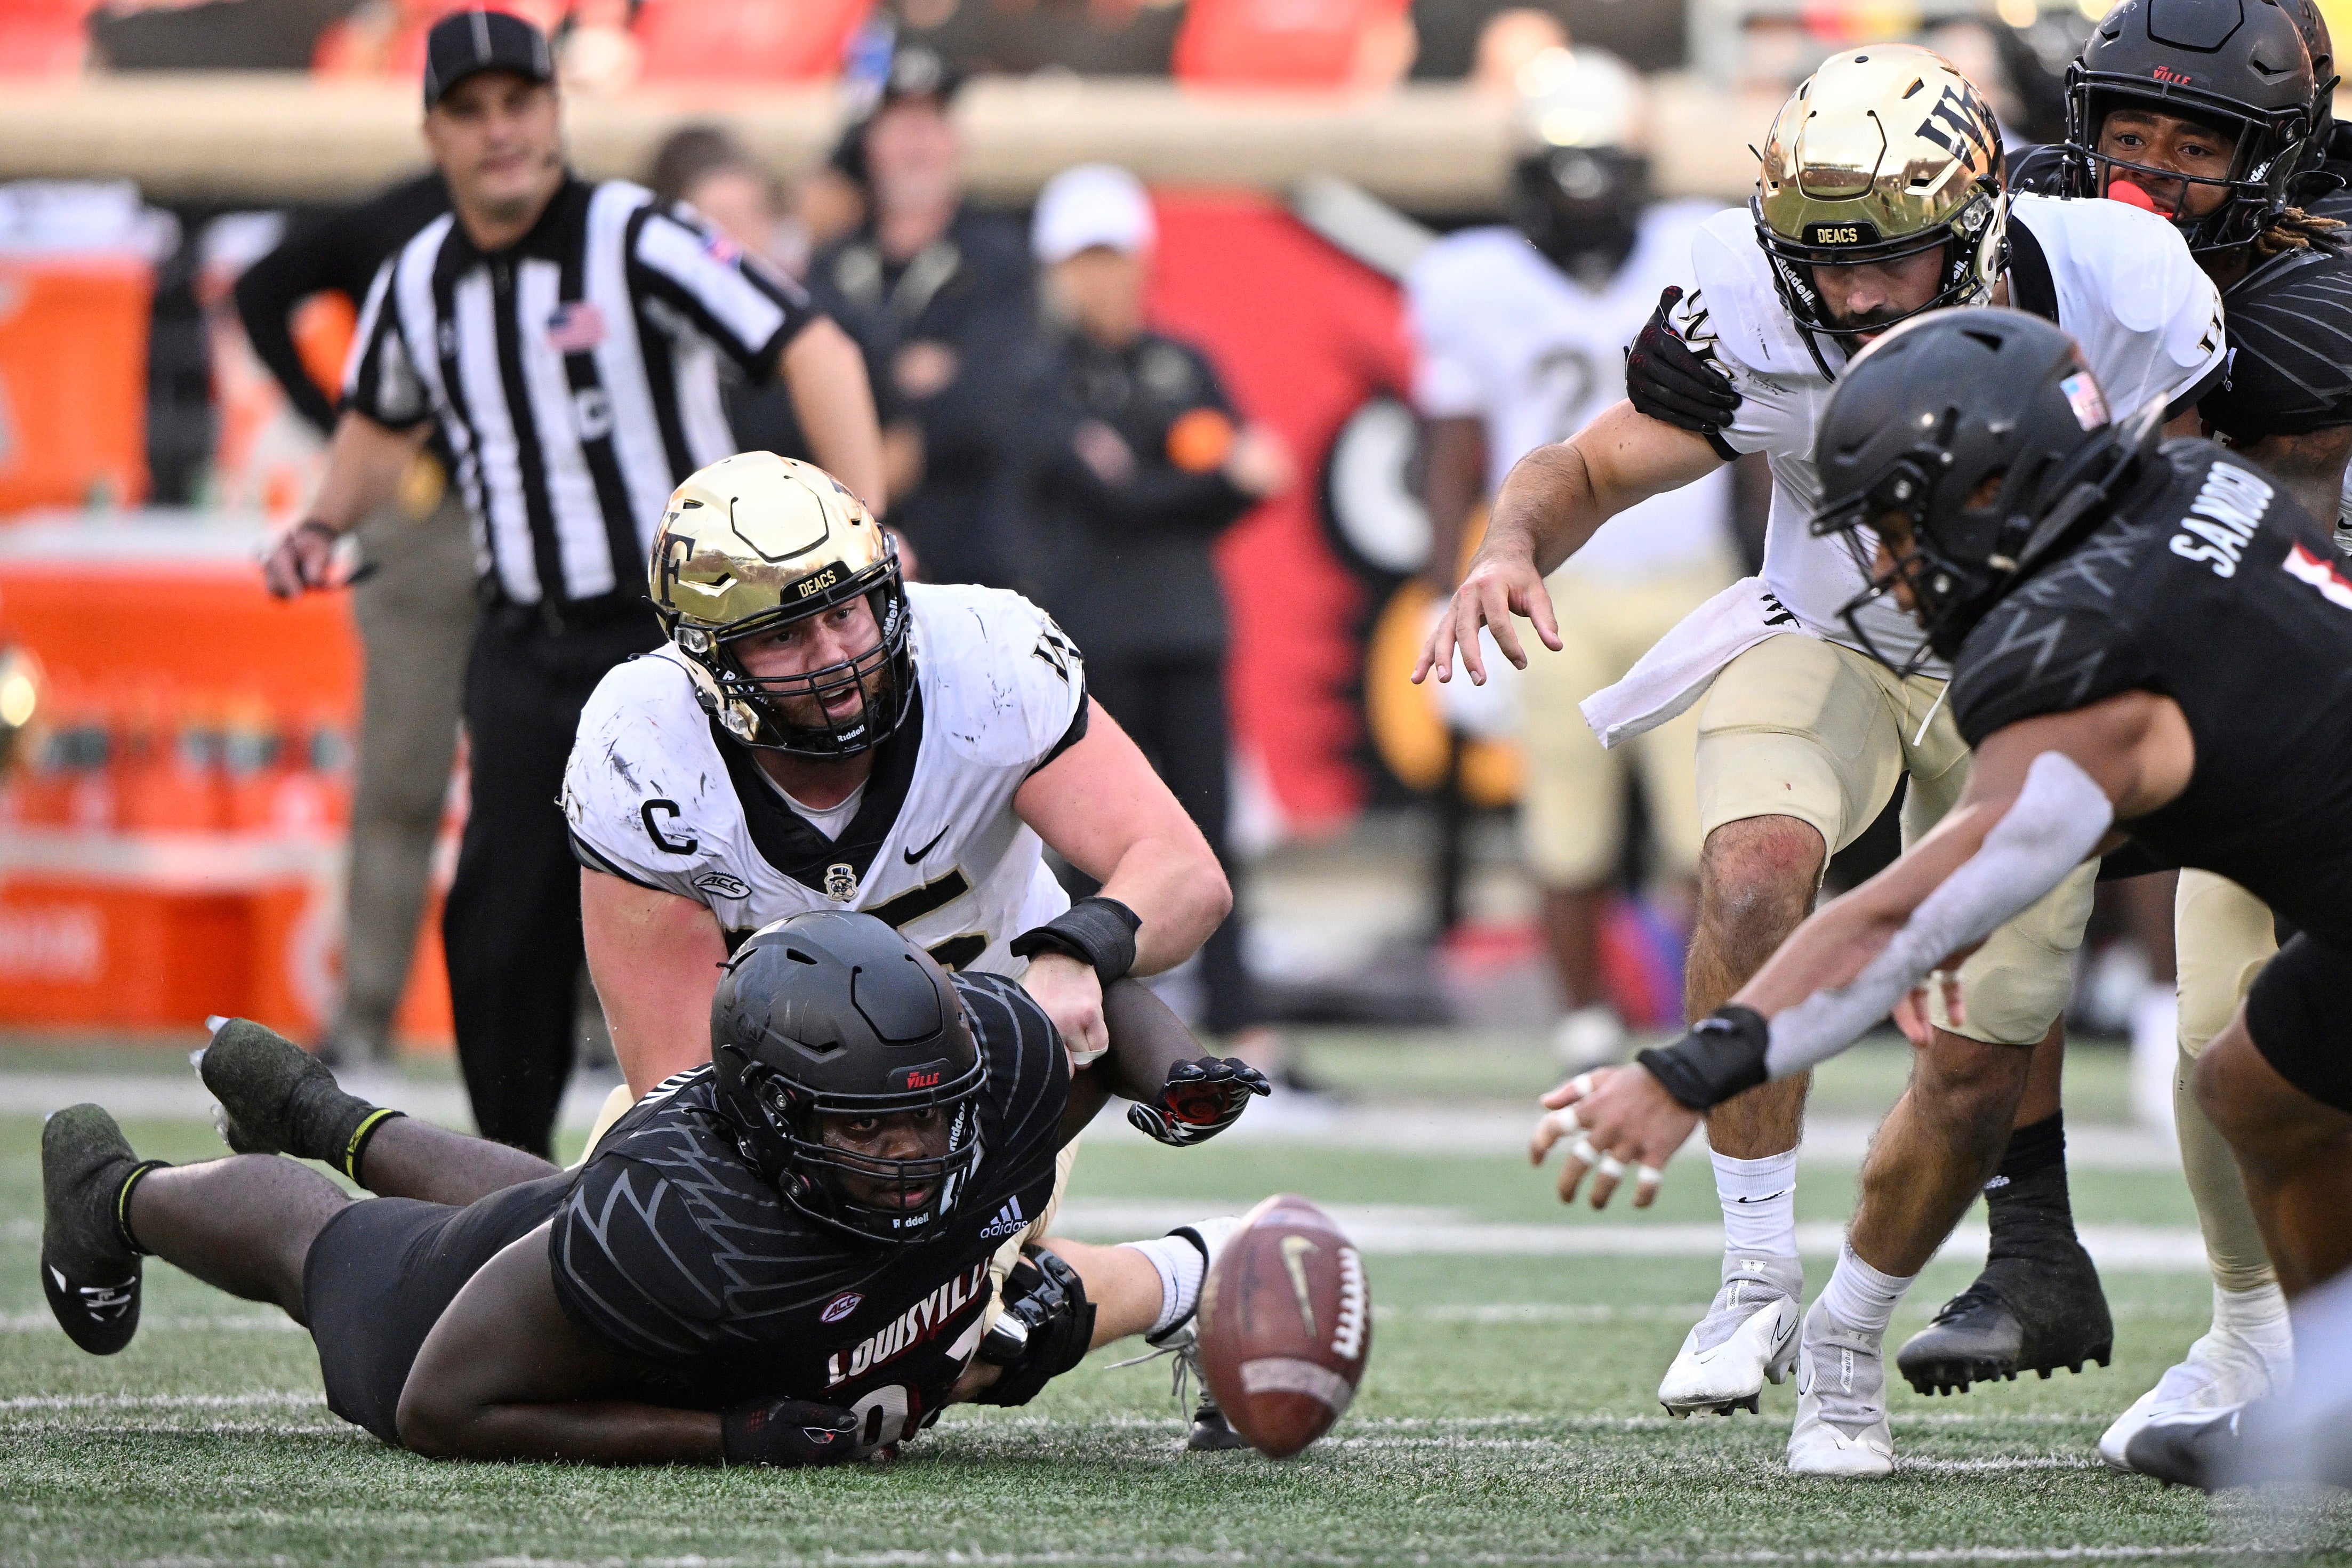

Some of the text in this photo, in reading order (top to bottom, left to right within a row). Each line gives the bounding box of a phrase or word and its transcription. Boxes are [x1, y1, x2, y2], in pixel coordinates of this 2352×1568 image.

[1817, 228, 1858, 243] DEACS
[798, 570, 837, 598] DEACS
[837, 724, 865, 742] Riddell
[641, 799, 697, 855] C
[697, 876, 744, 893] ACC
[907, 1072, 940, 1089] VILLE
[893, 1209, 929, 1228] Rddell
[825, 1296, 857, 1318] ACC
